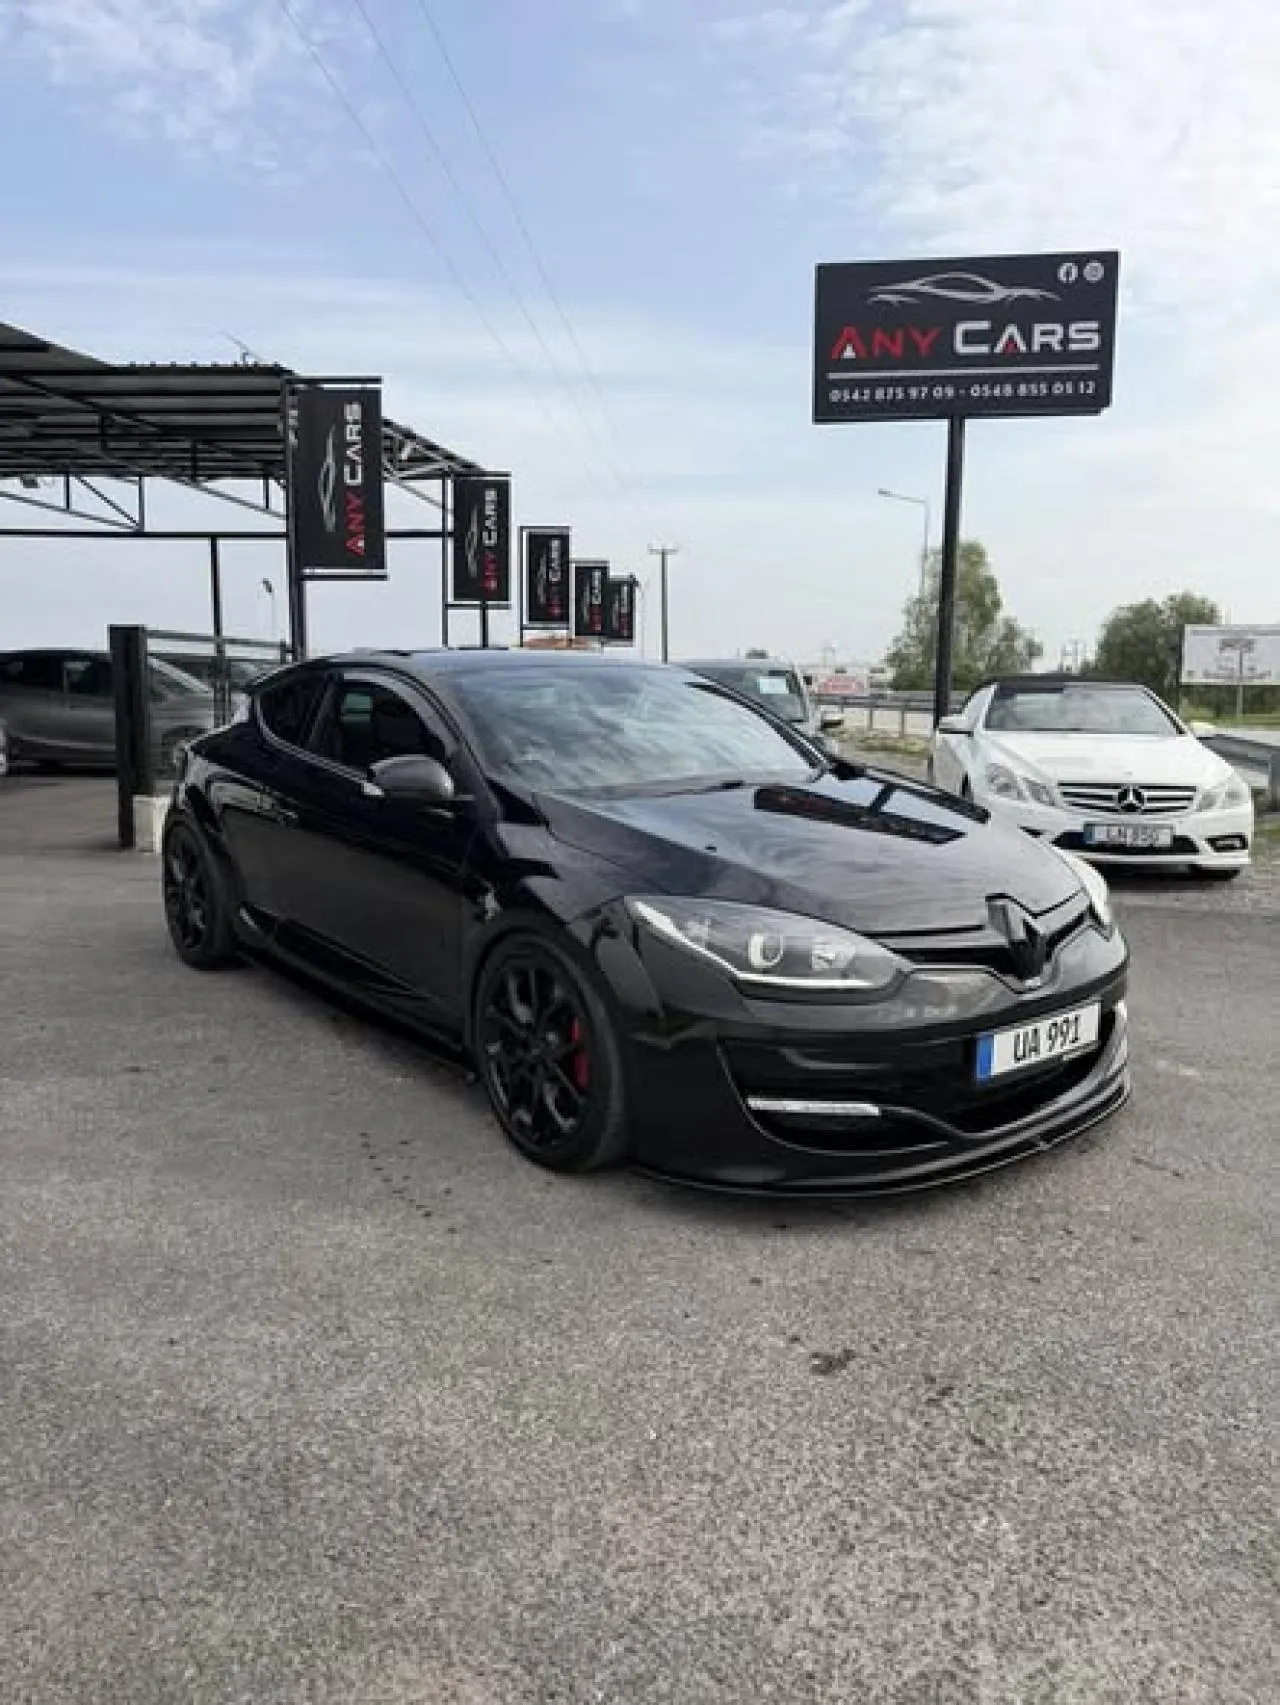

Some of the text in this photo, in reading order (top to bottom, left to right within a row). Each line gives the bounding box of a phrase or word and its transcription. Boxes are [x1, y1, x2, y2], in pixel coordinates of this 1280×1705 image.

[829, 320, 1101, 360] ANY CARS
[344, 401, 365, 556] ANY CARS
[482, 487, 498, 547] CARS
[1013, 1014, 1080, 1064] UA 991
